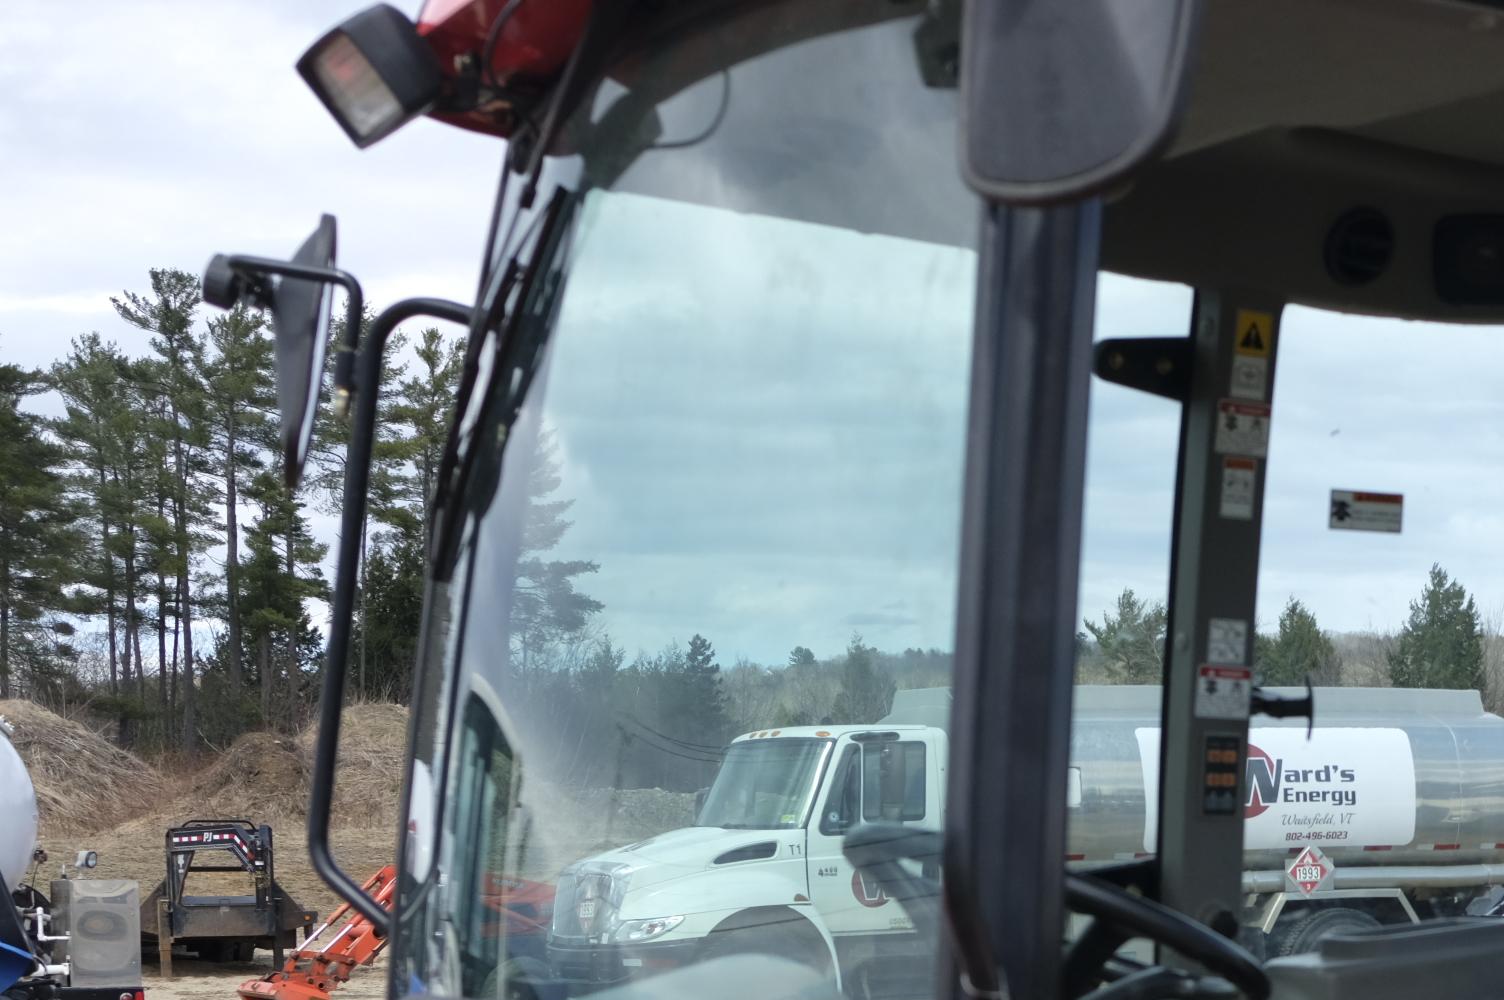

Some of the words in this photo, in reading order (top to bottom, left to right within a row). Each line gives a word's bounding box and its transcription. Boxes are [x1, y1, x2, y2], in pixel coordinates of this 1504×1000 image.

[1245, 758, 1355, 804] Ward's
[1283, 788, 1356, 806] Energy
[1340, 813, 1355, 826] VT
[203, 831, 213, 842] PJ
[1285, 831, 1348, 841] 802-496-6023
[1297, 867, 1320, 880] 1993
